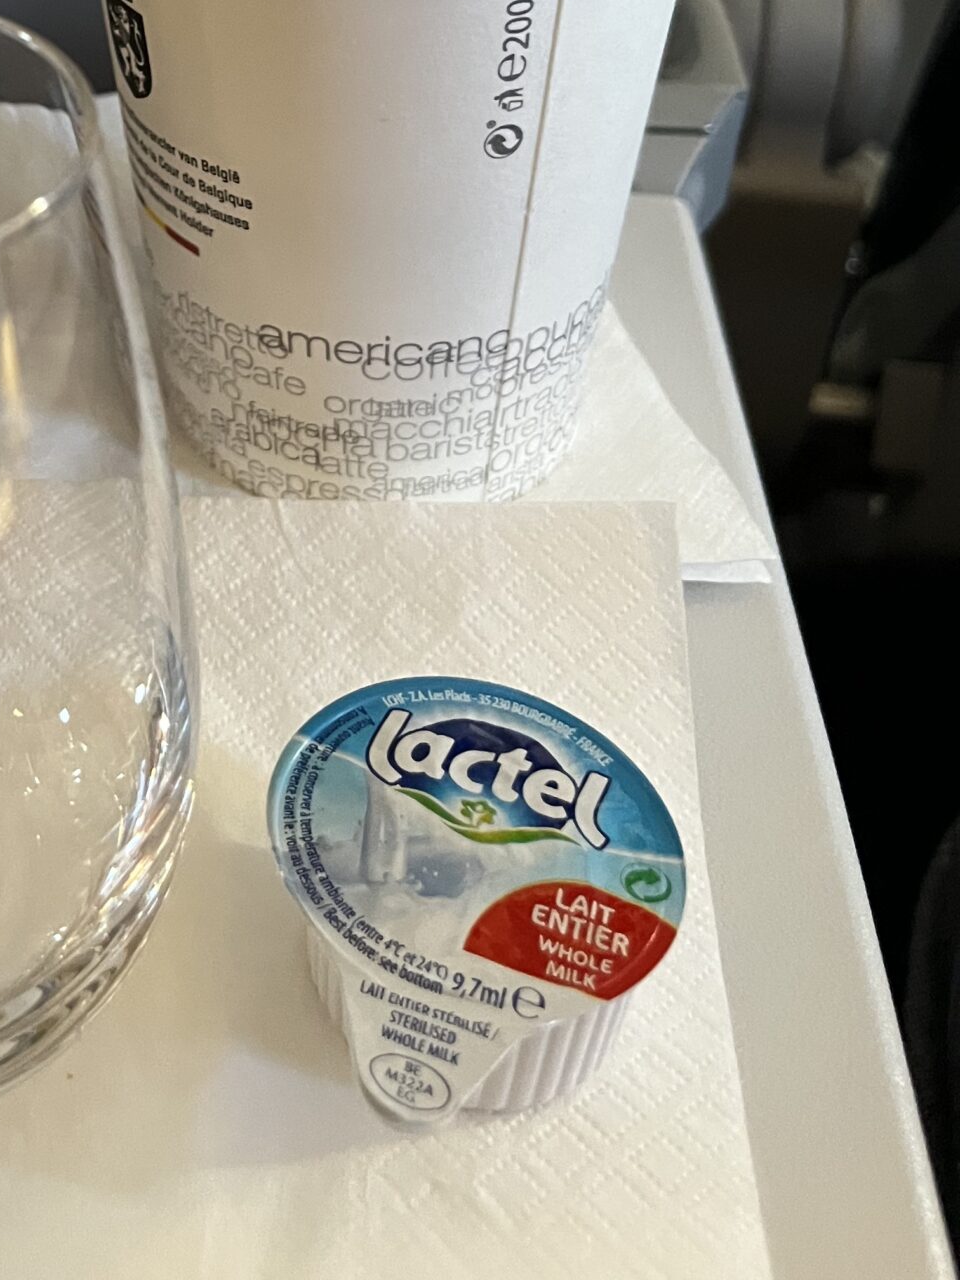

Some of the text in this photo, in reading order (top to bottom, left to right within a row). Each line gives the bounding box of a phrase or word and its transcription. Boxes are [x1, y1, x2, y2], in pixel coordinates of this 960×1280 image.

[178, 150, 198, 168] van
[182, 172, 196, 188] de
[198, 178, 253, 211] Belgique
[259, 324, 507, 366] americano
[428, 689, 444, 702] Les
[492, 696, 510, 711] 230
[576, 736, 614, 768] FRANCE
[366, 708, 611, 850] lactel
[290, 854, 304, 867] au
[296, 868, 324, 905] dessous
[319, 875, 357, 920] ambiante
[403, 950, 417, 966] et
[323, 907, 347, 933] Best
[556, 887, 616, 925] LAIT
[531, 904, 630, 957] ENTIER
[377, 956, 398, 974] see
[539, 934, 614, 974] WHOLE
[398, 964, 444, 995] bottom
[451, 972, 508, 1010] 9,7ml
[545, 960, 597, 991] MILK
[360, 979, 386, 1000] LAIT
[388, 992, 431, 1016] ENTIER
[381, 1024, 461, 1066] WHOLE MILK
[389, 1010, 457, 1045] STERILISED
[404, 1060, 423, 1076] BE
